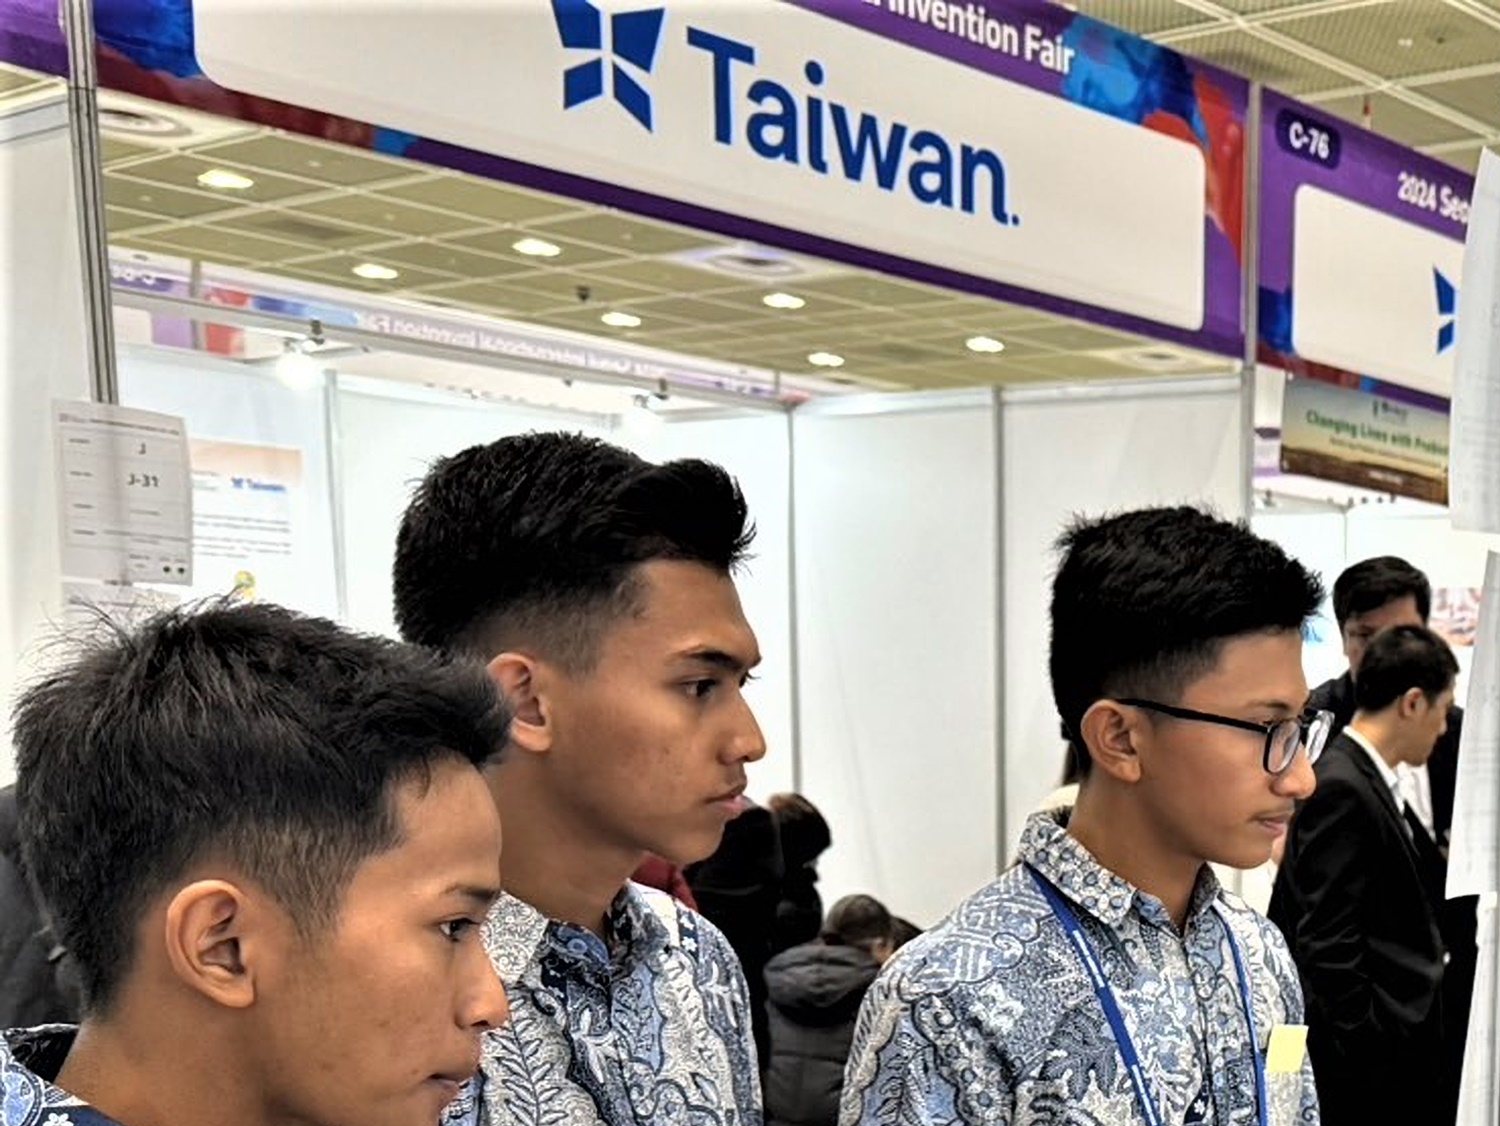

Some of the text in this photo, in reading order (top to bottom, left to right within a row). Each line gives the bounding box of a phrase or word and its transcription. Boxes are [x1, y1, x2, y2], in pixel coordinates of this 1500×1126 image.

[1024, 24, 1075, 74] Fair
[1289, 121, 1329, 159] C-76
[1397, 171, 1436, 212] 2024
[1439, 185, 1473, 223] Seo
[127, 474, 160, 488] J-31
